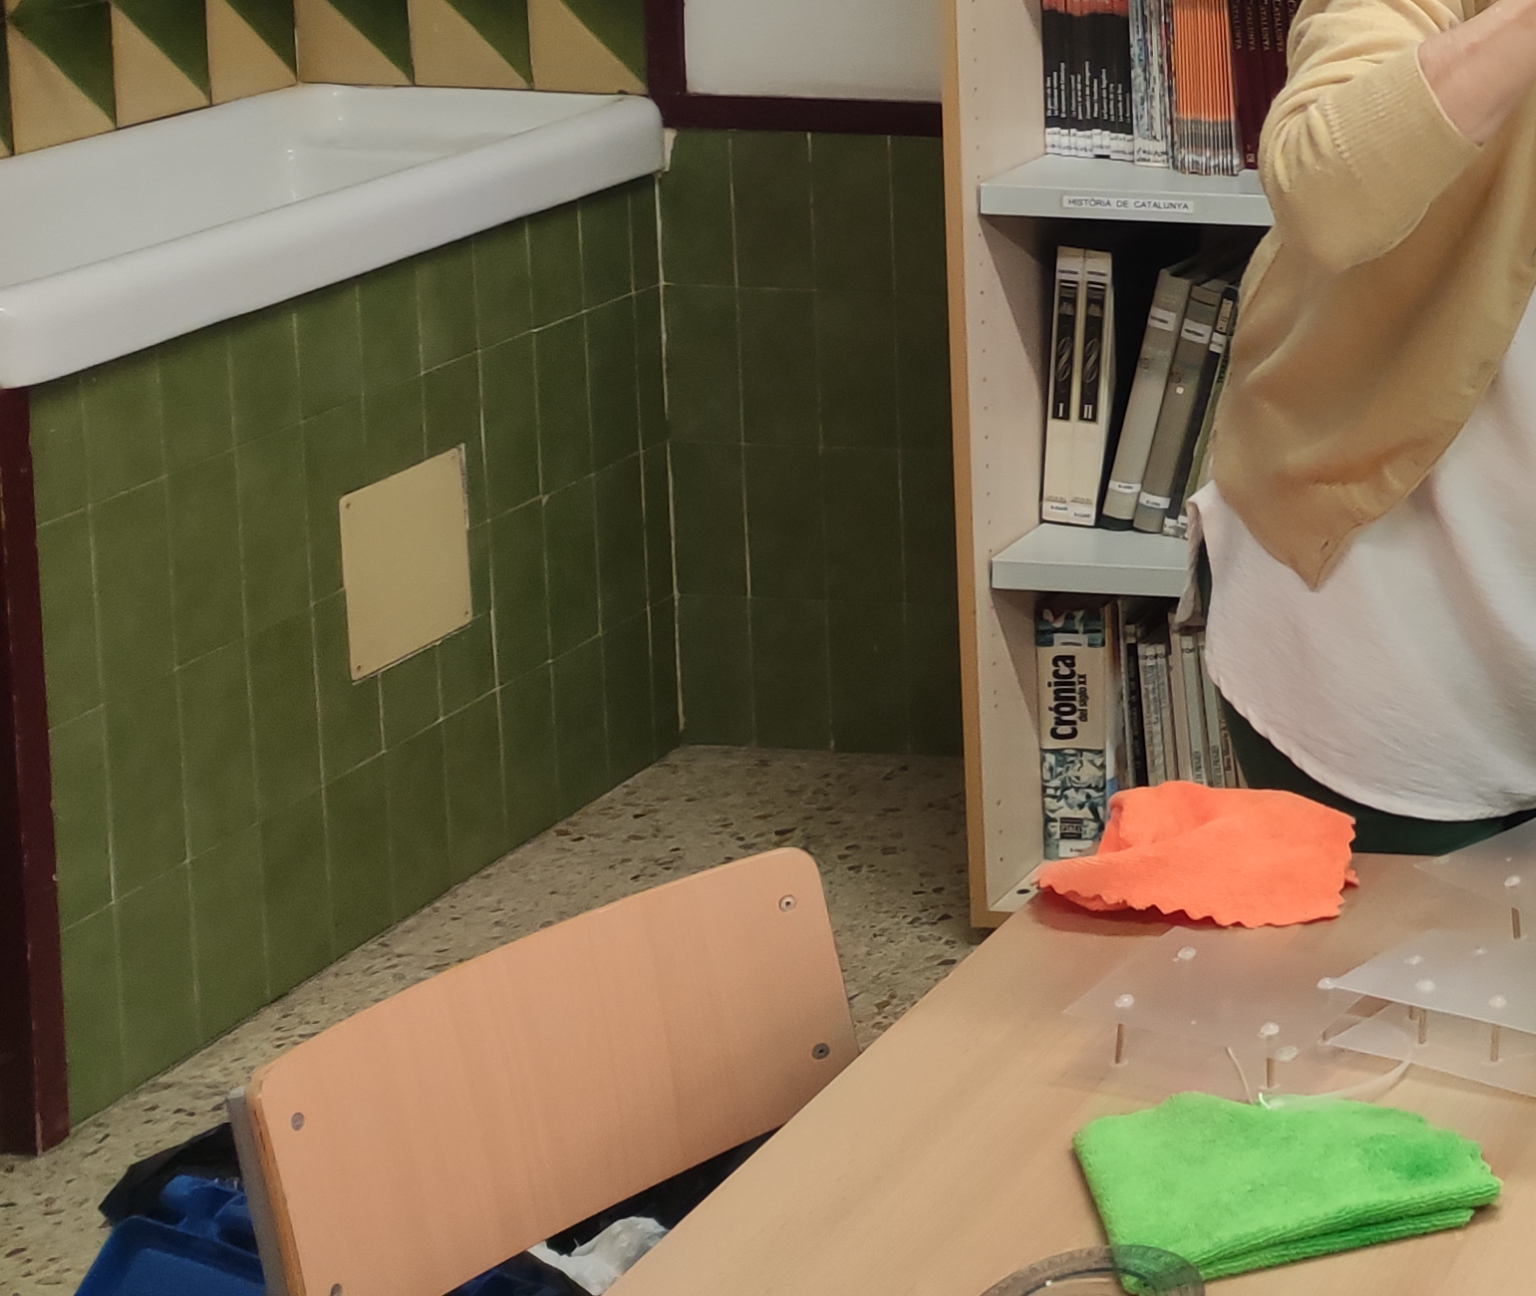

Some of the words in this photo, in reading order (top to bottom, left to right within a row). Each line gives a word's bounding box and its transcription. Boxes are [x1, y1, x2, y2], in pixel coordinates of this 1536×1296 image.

[1068, 197, 1111, 208] HISTÒRIA
[1117, 200, 1129, 208] DE
[1134, 201, 1189, 211] CATALUNYA
[1078, 673, 1087, 686] XX
[1048, 654, 1078, 741] Crónica
[1078, 687, 1088, 707] siglo
[1078, 708, 1088, 722] del
